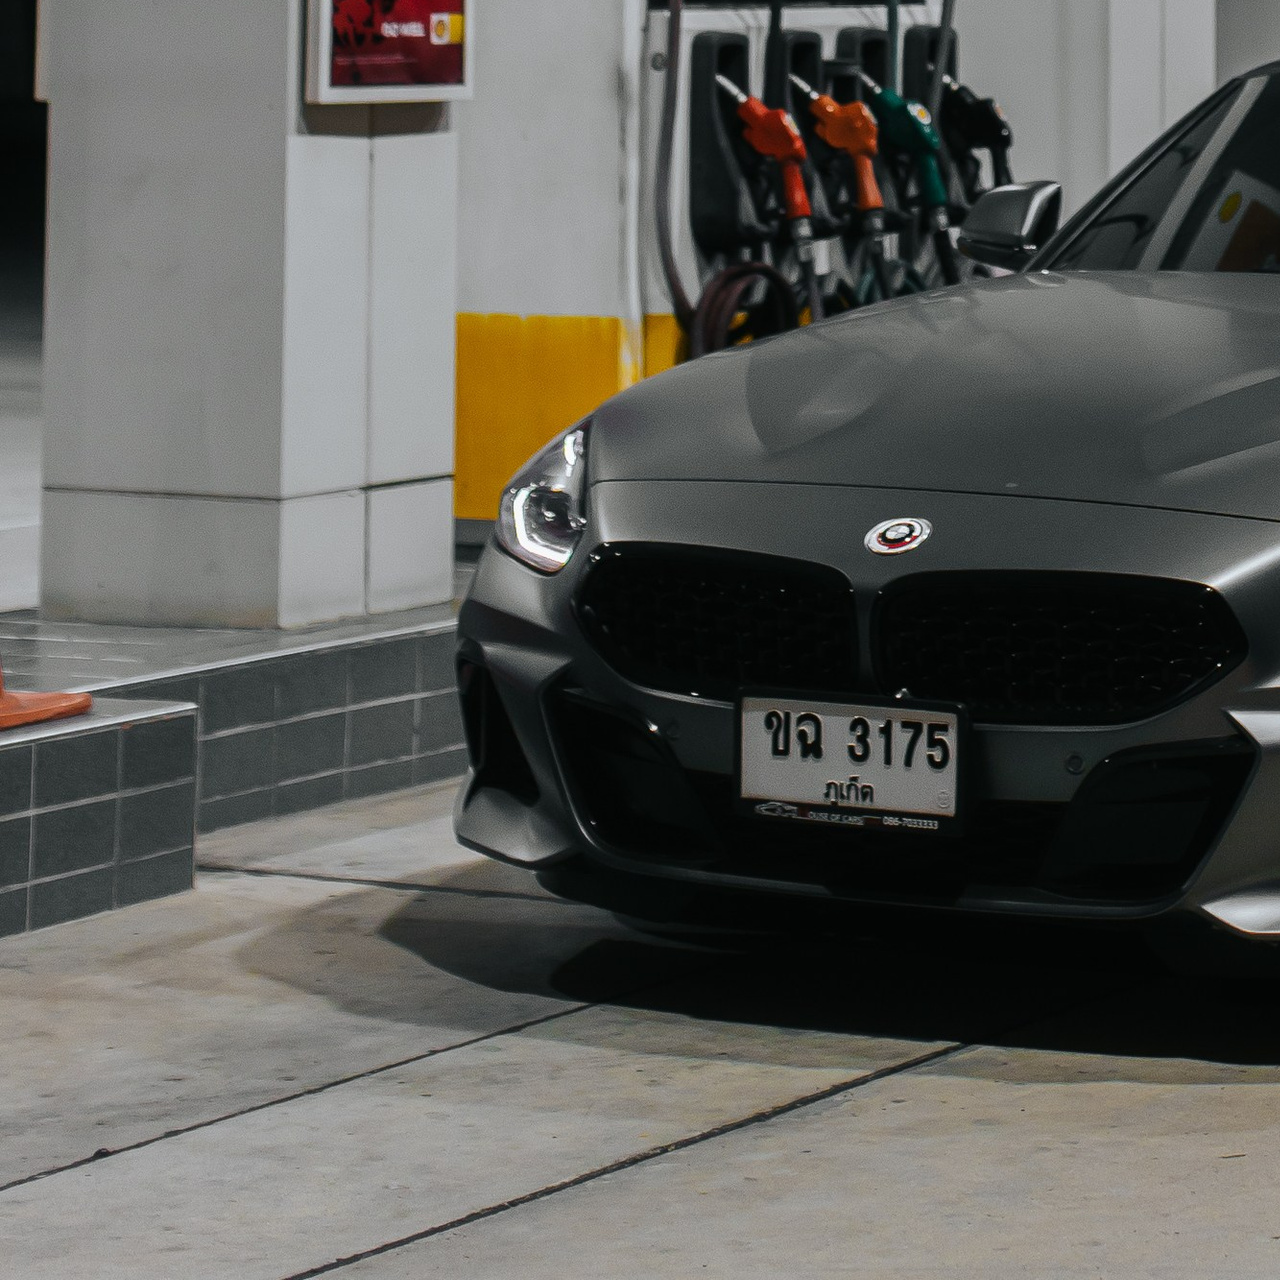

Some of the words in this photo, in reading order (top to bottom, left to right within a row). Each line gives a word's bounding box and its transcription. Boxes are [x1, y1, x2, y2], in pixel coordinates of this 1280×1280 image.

[764, 710, 824, 760] ขฉ
[848, 716, 950, 770] 3175
[824, 775, 875, 805] ภูเก็ต
